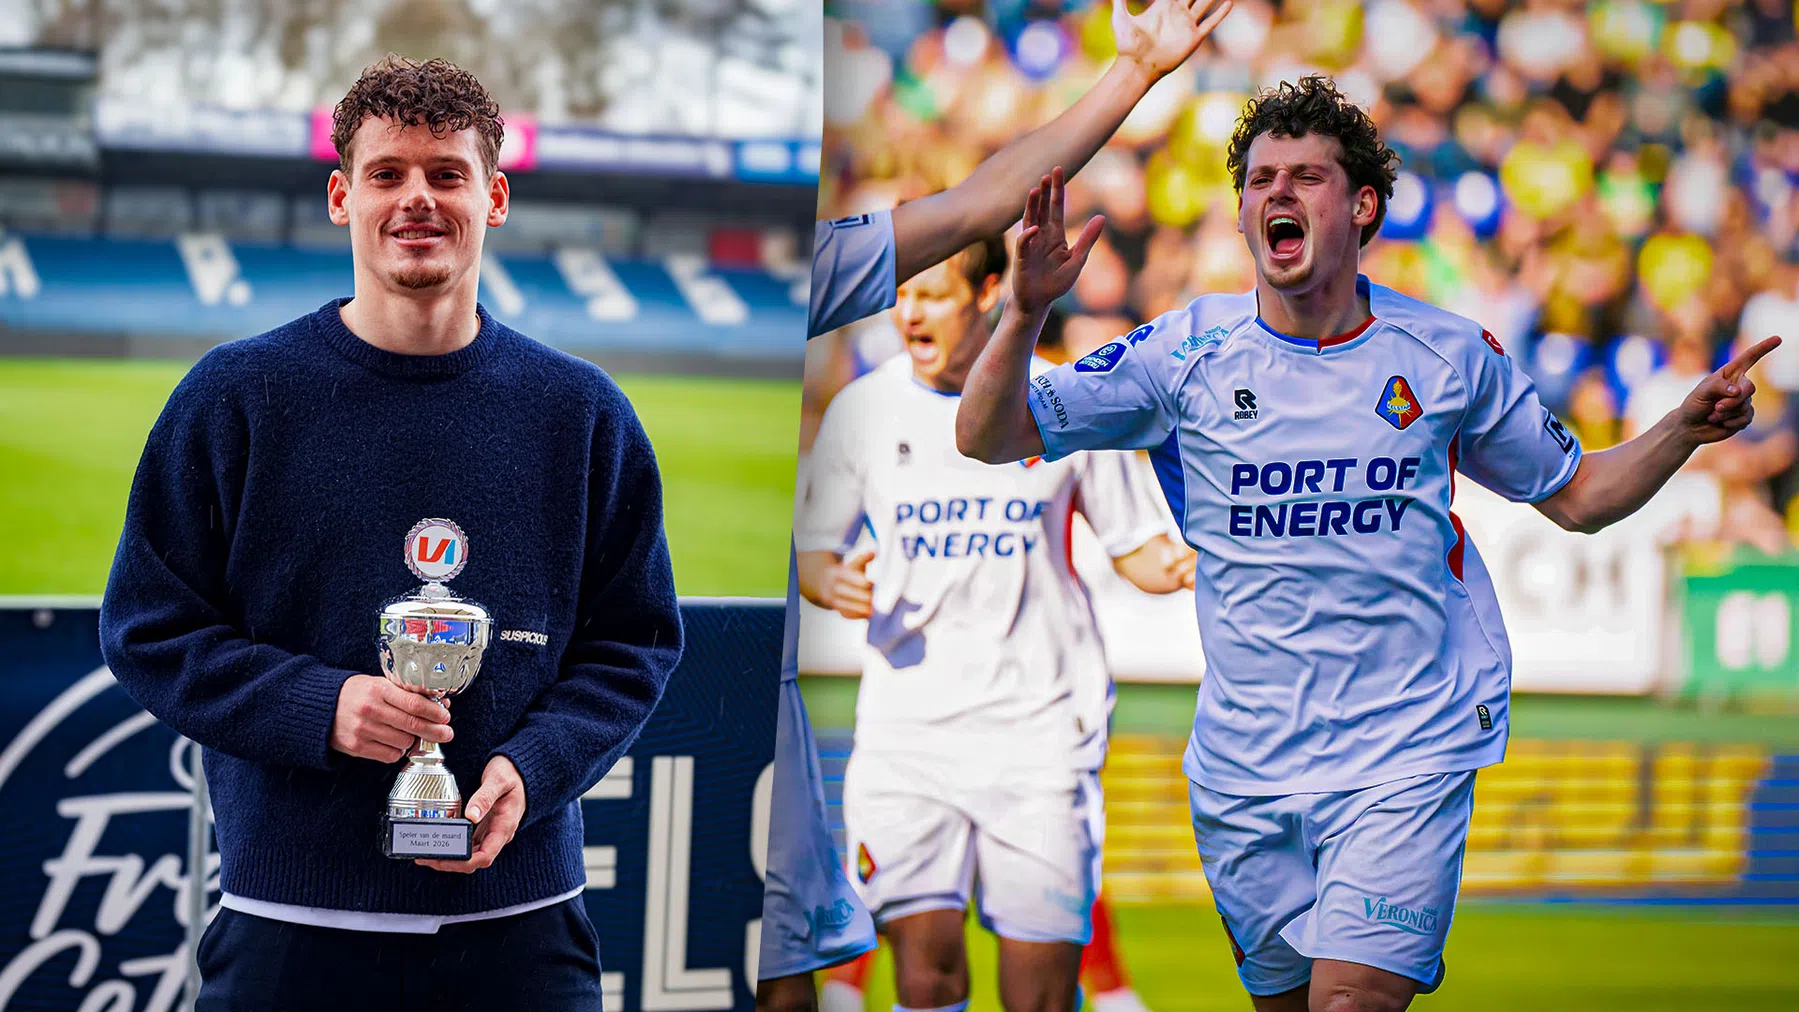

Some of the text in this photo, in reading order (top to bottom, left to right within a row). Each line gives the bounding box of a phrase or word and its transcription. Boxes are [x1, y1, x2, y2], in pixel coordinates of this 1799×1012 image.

[1050, 396, 1069, 429] SODA
[1234, 410, 1258, 420] ROBEY
[1231, 457, 1421, 496] PORT OF
[896, 498, 994, 524] PORT
[1229, 499, 1417, 538] ENERGY
[400, 831, 417, 839] Speler
[1362, 896, 1437, 932] VERONICA
